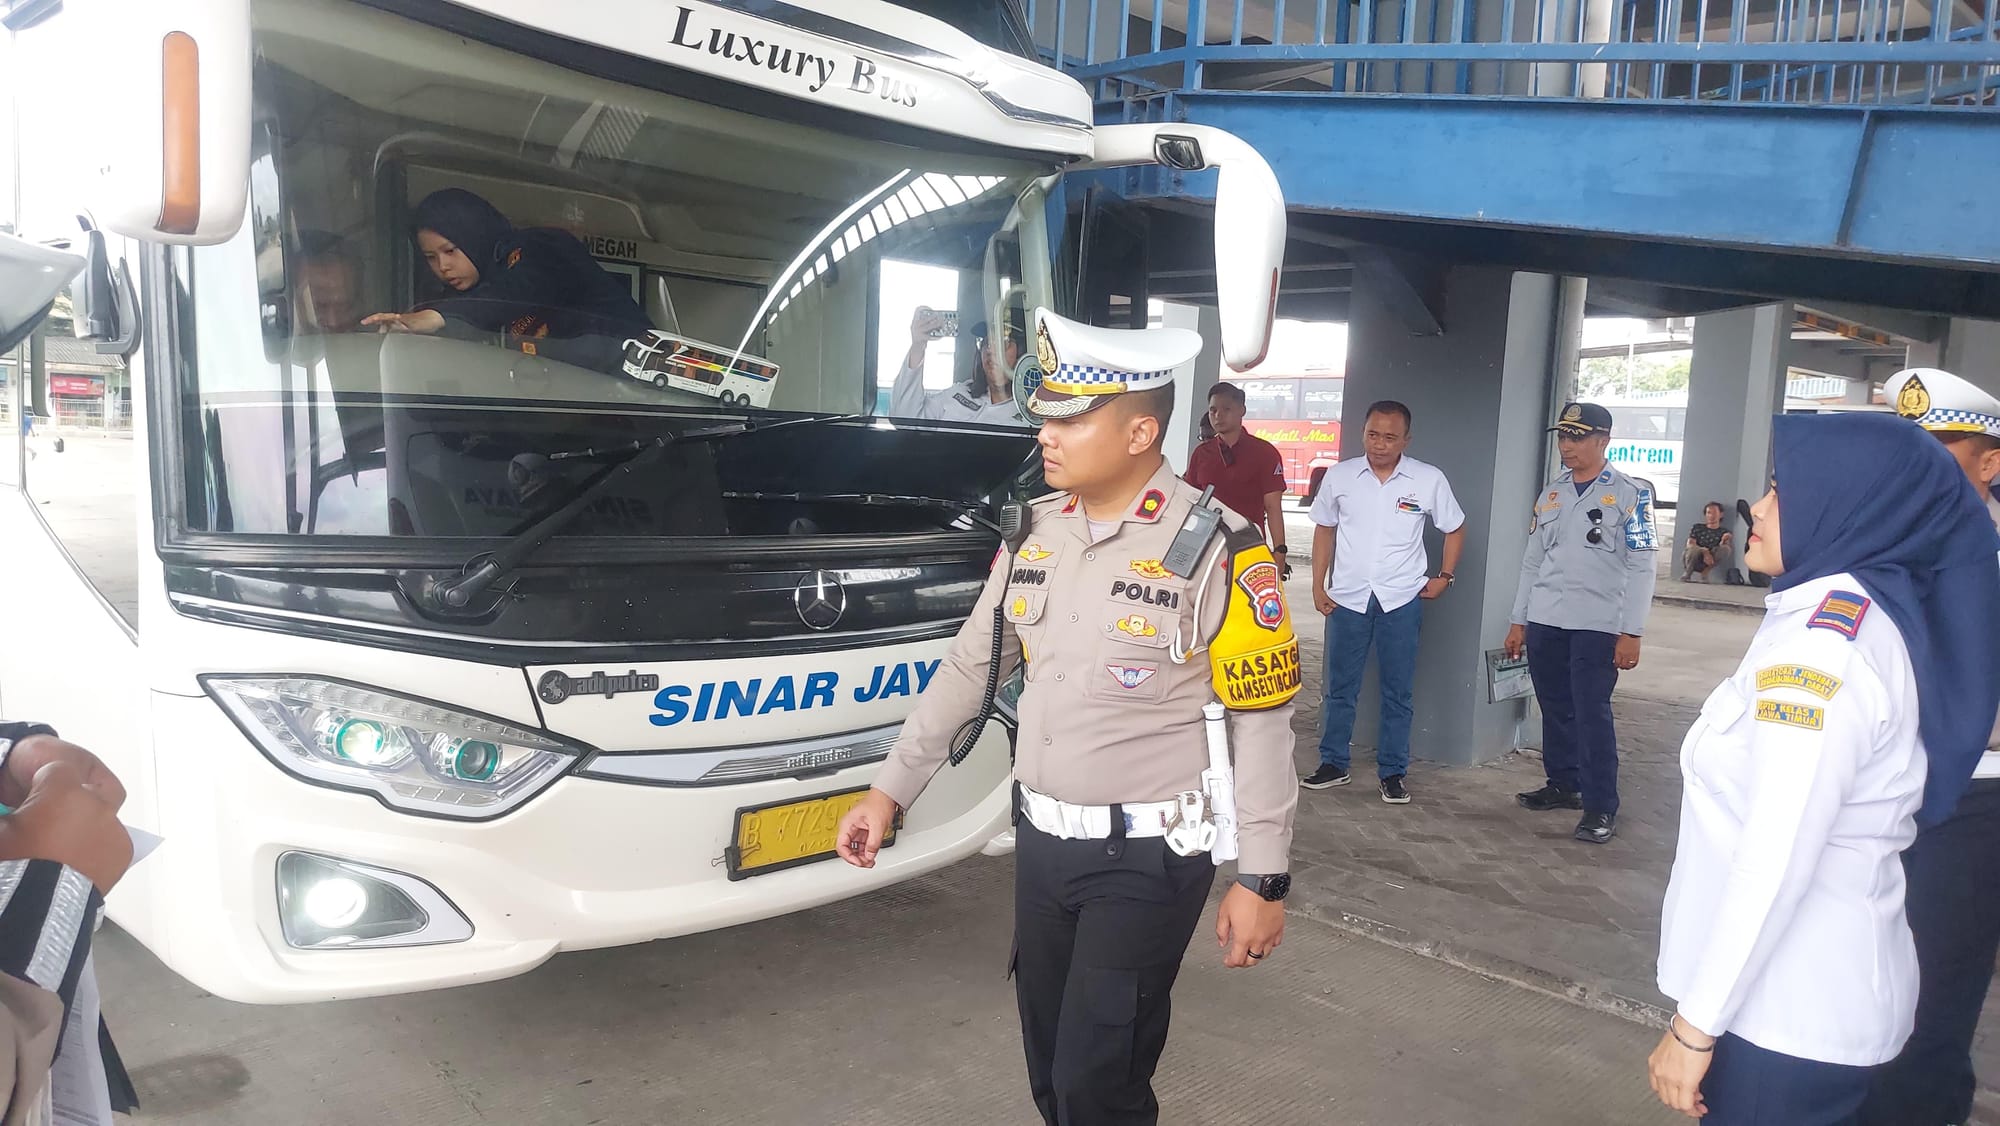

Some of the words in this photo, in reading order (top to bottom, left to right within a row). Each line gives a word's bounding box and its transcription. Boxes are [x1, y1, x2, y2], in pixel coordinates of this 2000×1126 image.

[667, 6, 835, 93] Luxury
[847, 55, 918, 108] Bus
[1302, 428, 1336, 443] Mas
[1607, 444, 1674, 464] entrem
[1110, 580, 1180, 609] POLRI
[1223, 645, 1299, 682] KASATG
[649, 671, 840, 727] SINAR
[853, 658, 943, 703] JAY
[1780, 704, 1809, 717] KELAS
[1786, 712, 1817, 727] TIMUR
[745, 814, 762, 846] B
[777, 802, 841, 842] 7729
